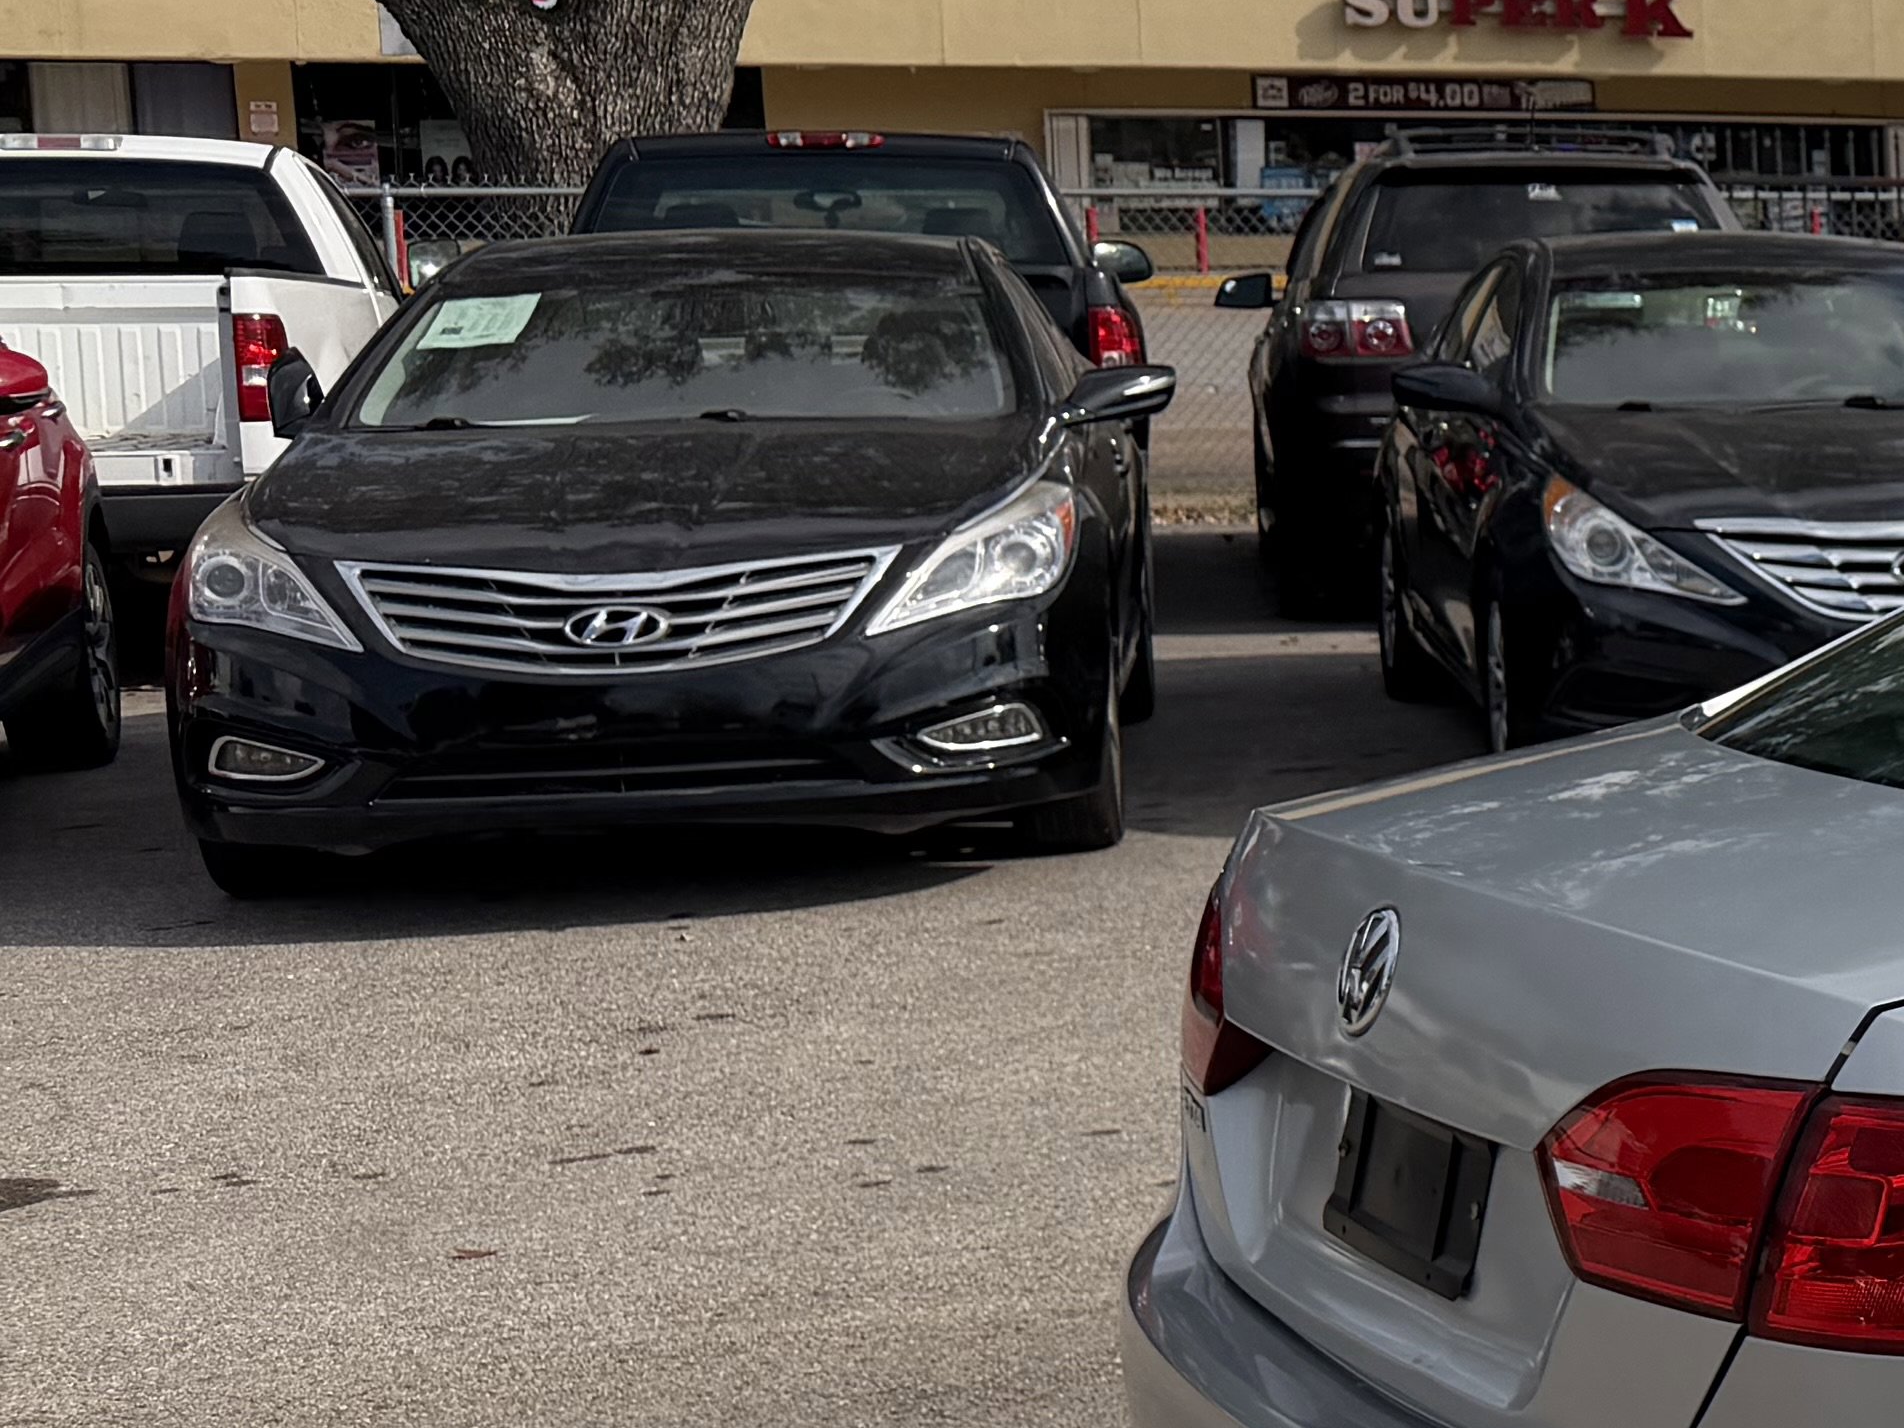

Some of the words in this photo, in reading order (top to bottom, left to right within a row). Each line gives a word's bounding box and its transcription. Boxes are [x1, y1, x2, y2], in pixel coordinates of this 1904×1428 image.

[1347, 84, 1366, 106] 2
[1368, 84, 1405, 104] FOR
[1408, 83, 1481, 108] $4.00
